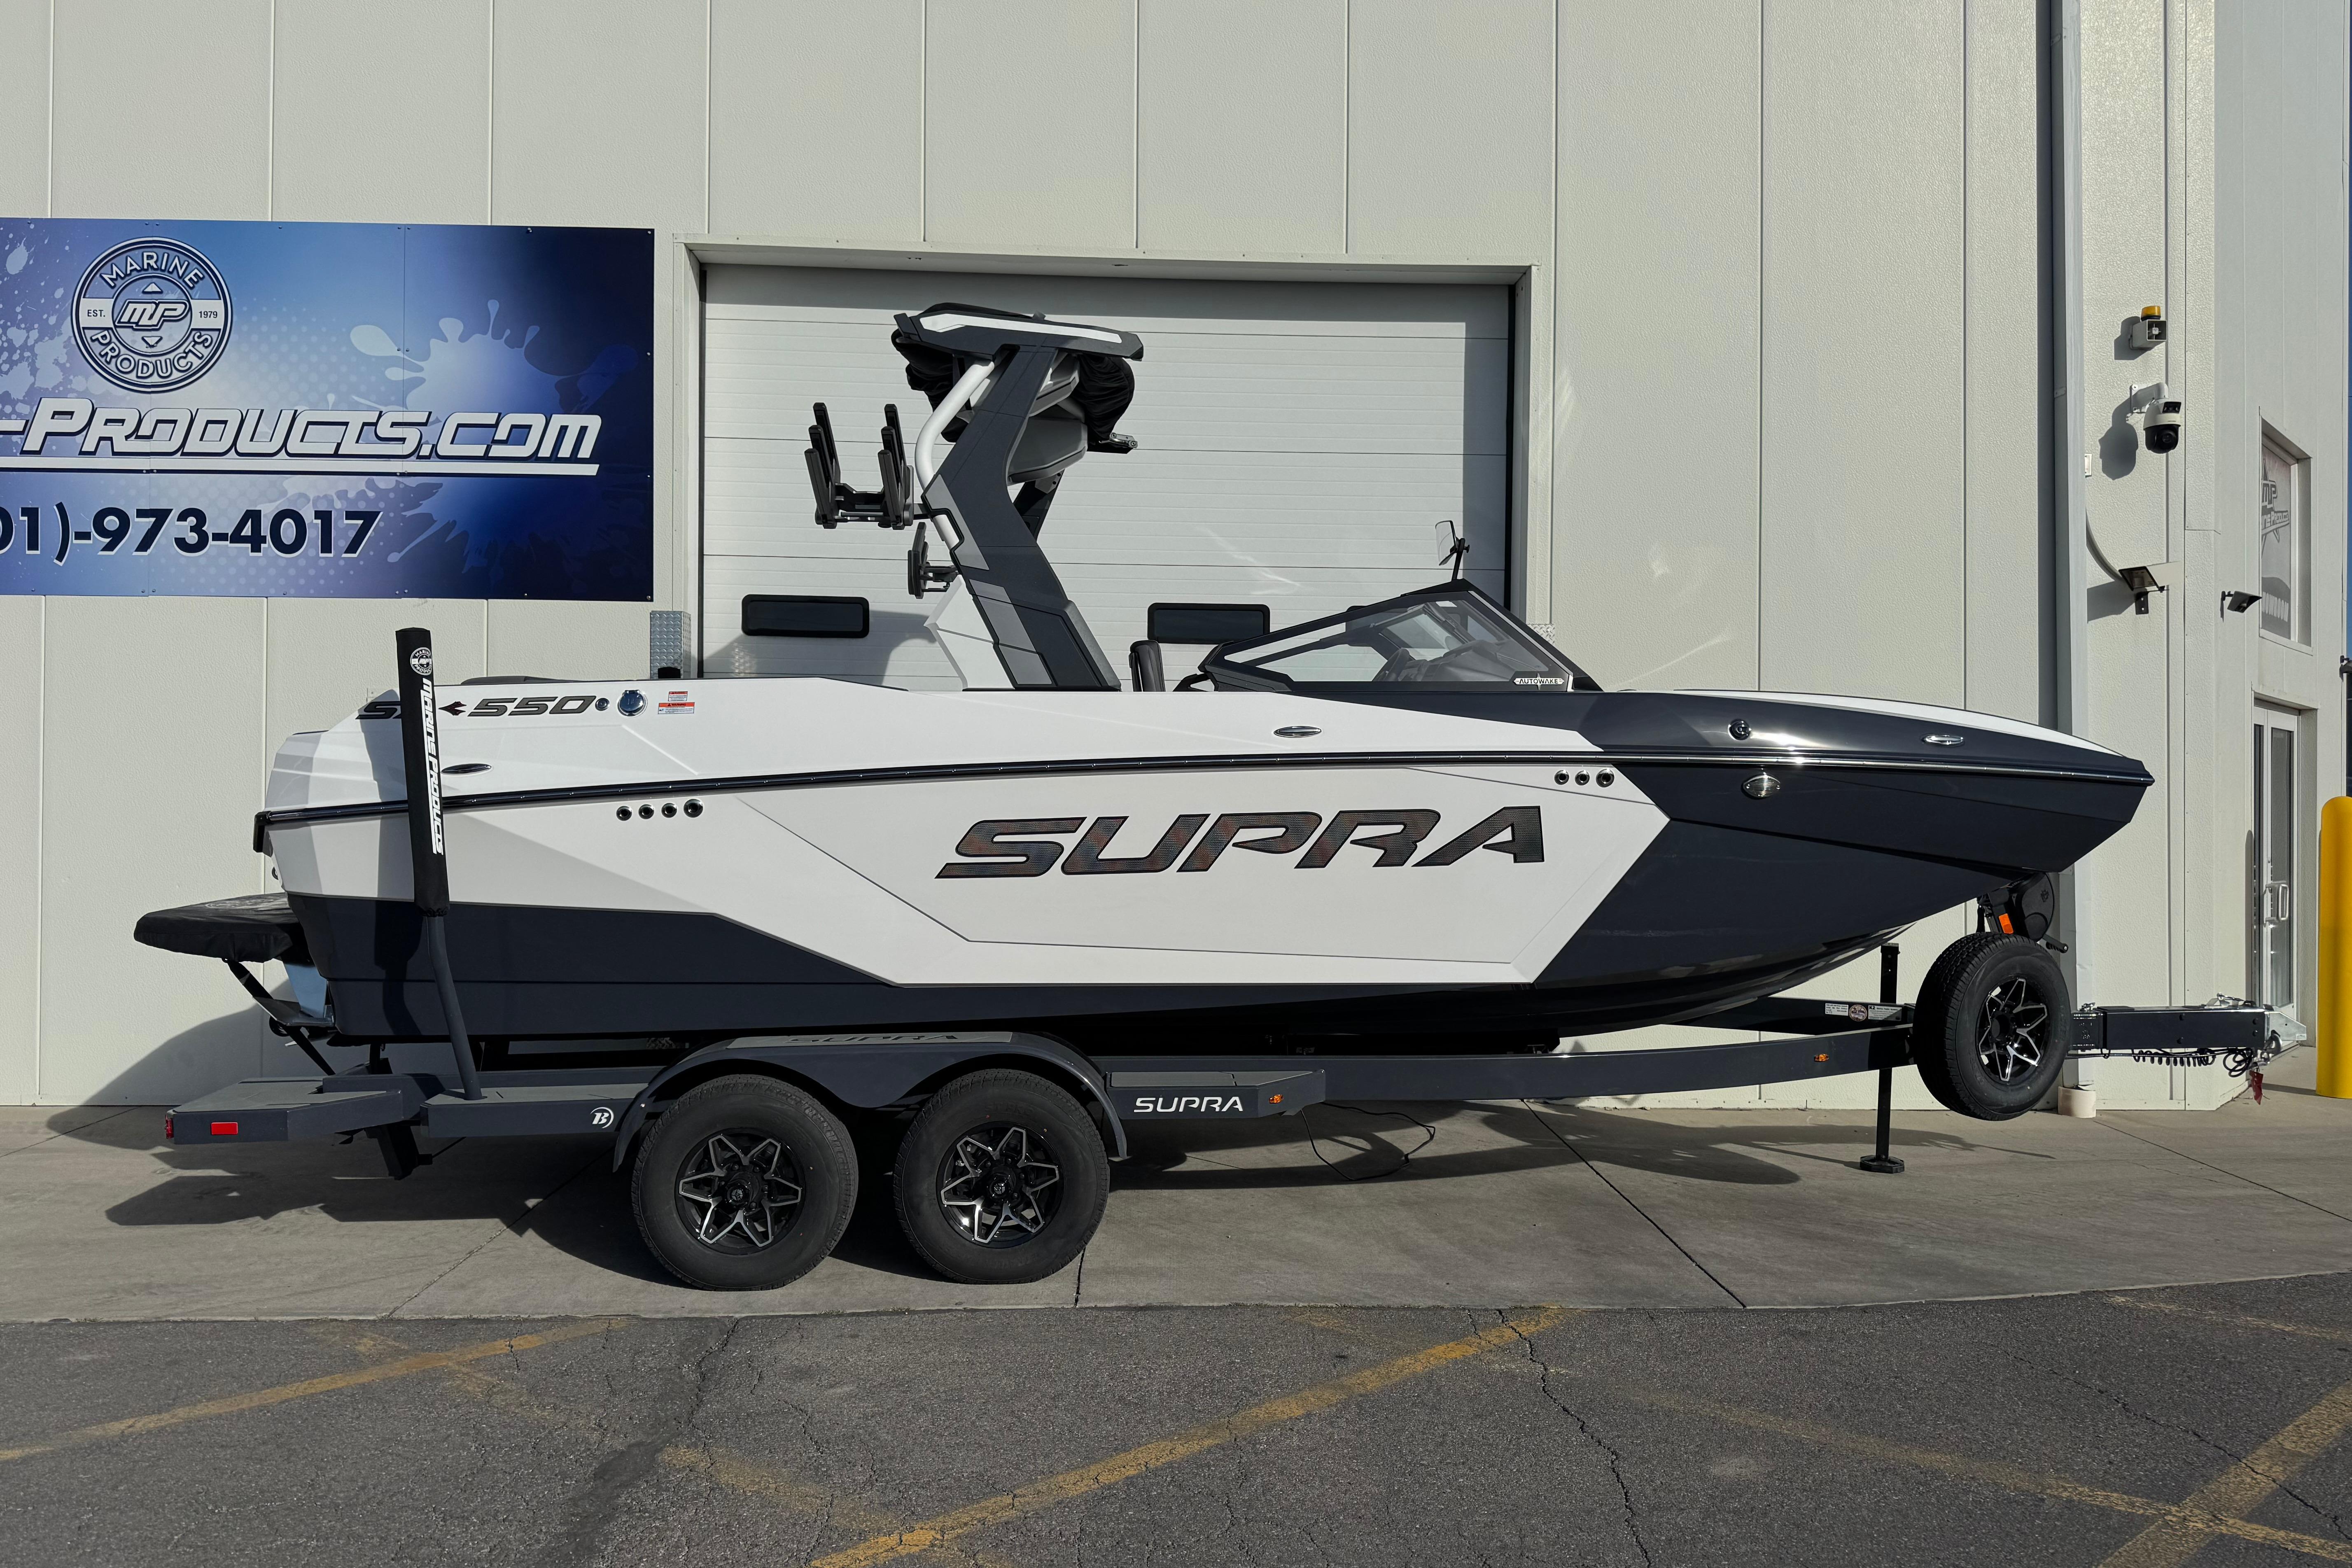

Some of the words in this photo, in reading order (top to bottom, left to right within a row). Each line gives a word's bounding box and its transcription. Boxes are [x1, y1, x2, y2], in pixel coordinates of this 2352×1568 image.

[100, 252, 204, 288] MARINE
[91, 330, 212, 377] PRODUCTS
[355, 701, 401, 720] S
[467, 695, 597, 717] 550
[420, 678, 436, 756] MARINE
[429, 755, 443, 855] PRODUCTS
[934, 806, 1545, 879] SUPRA
[785, 1035, 958, 1043] SUPRA
[1134, 1097, 1243, 1113] SUPRA
